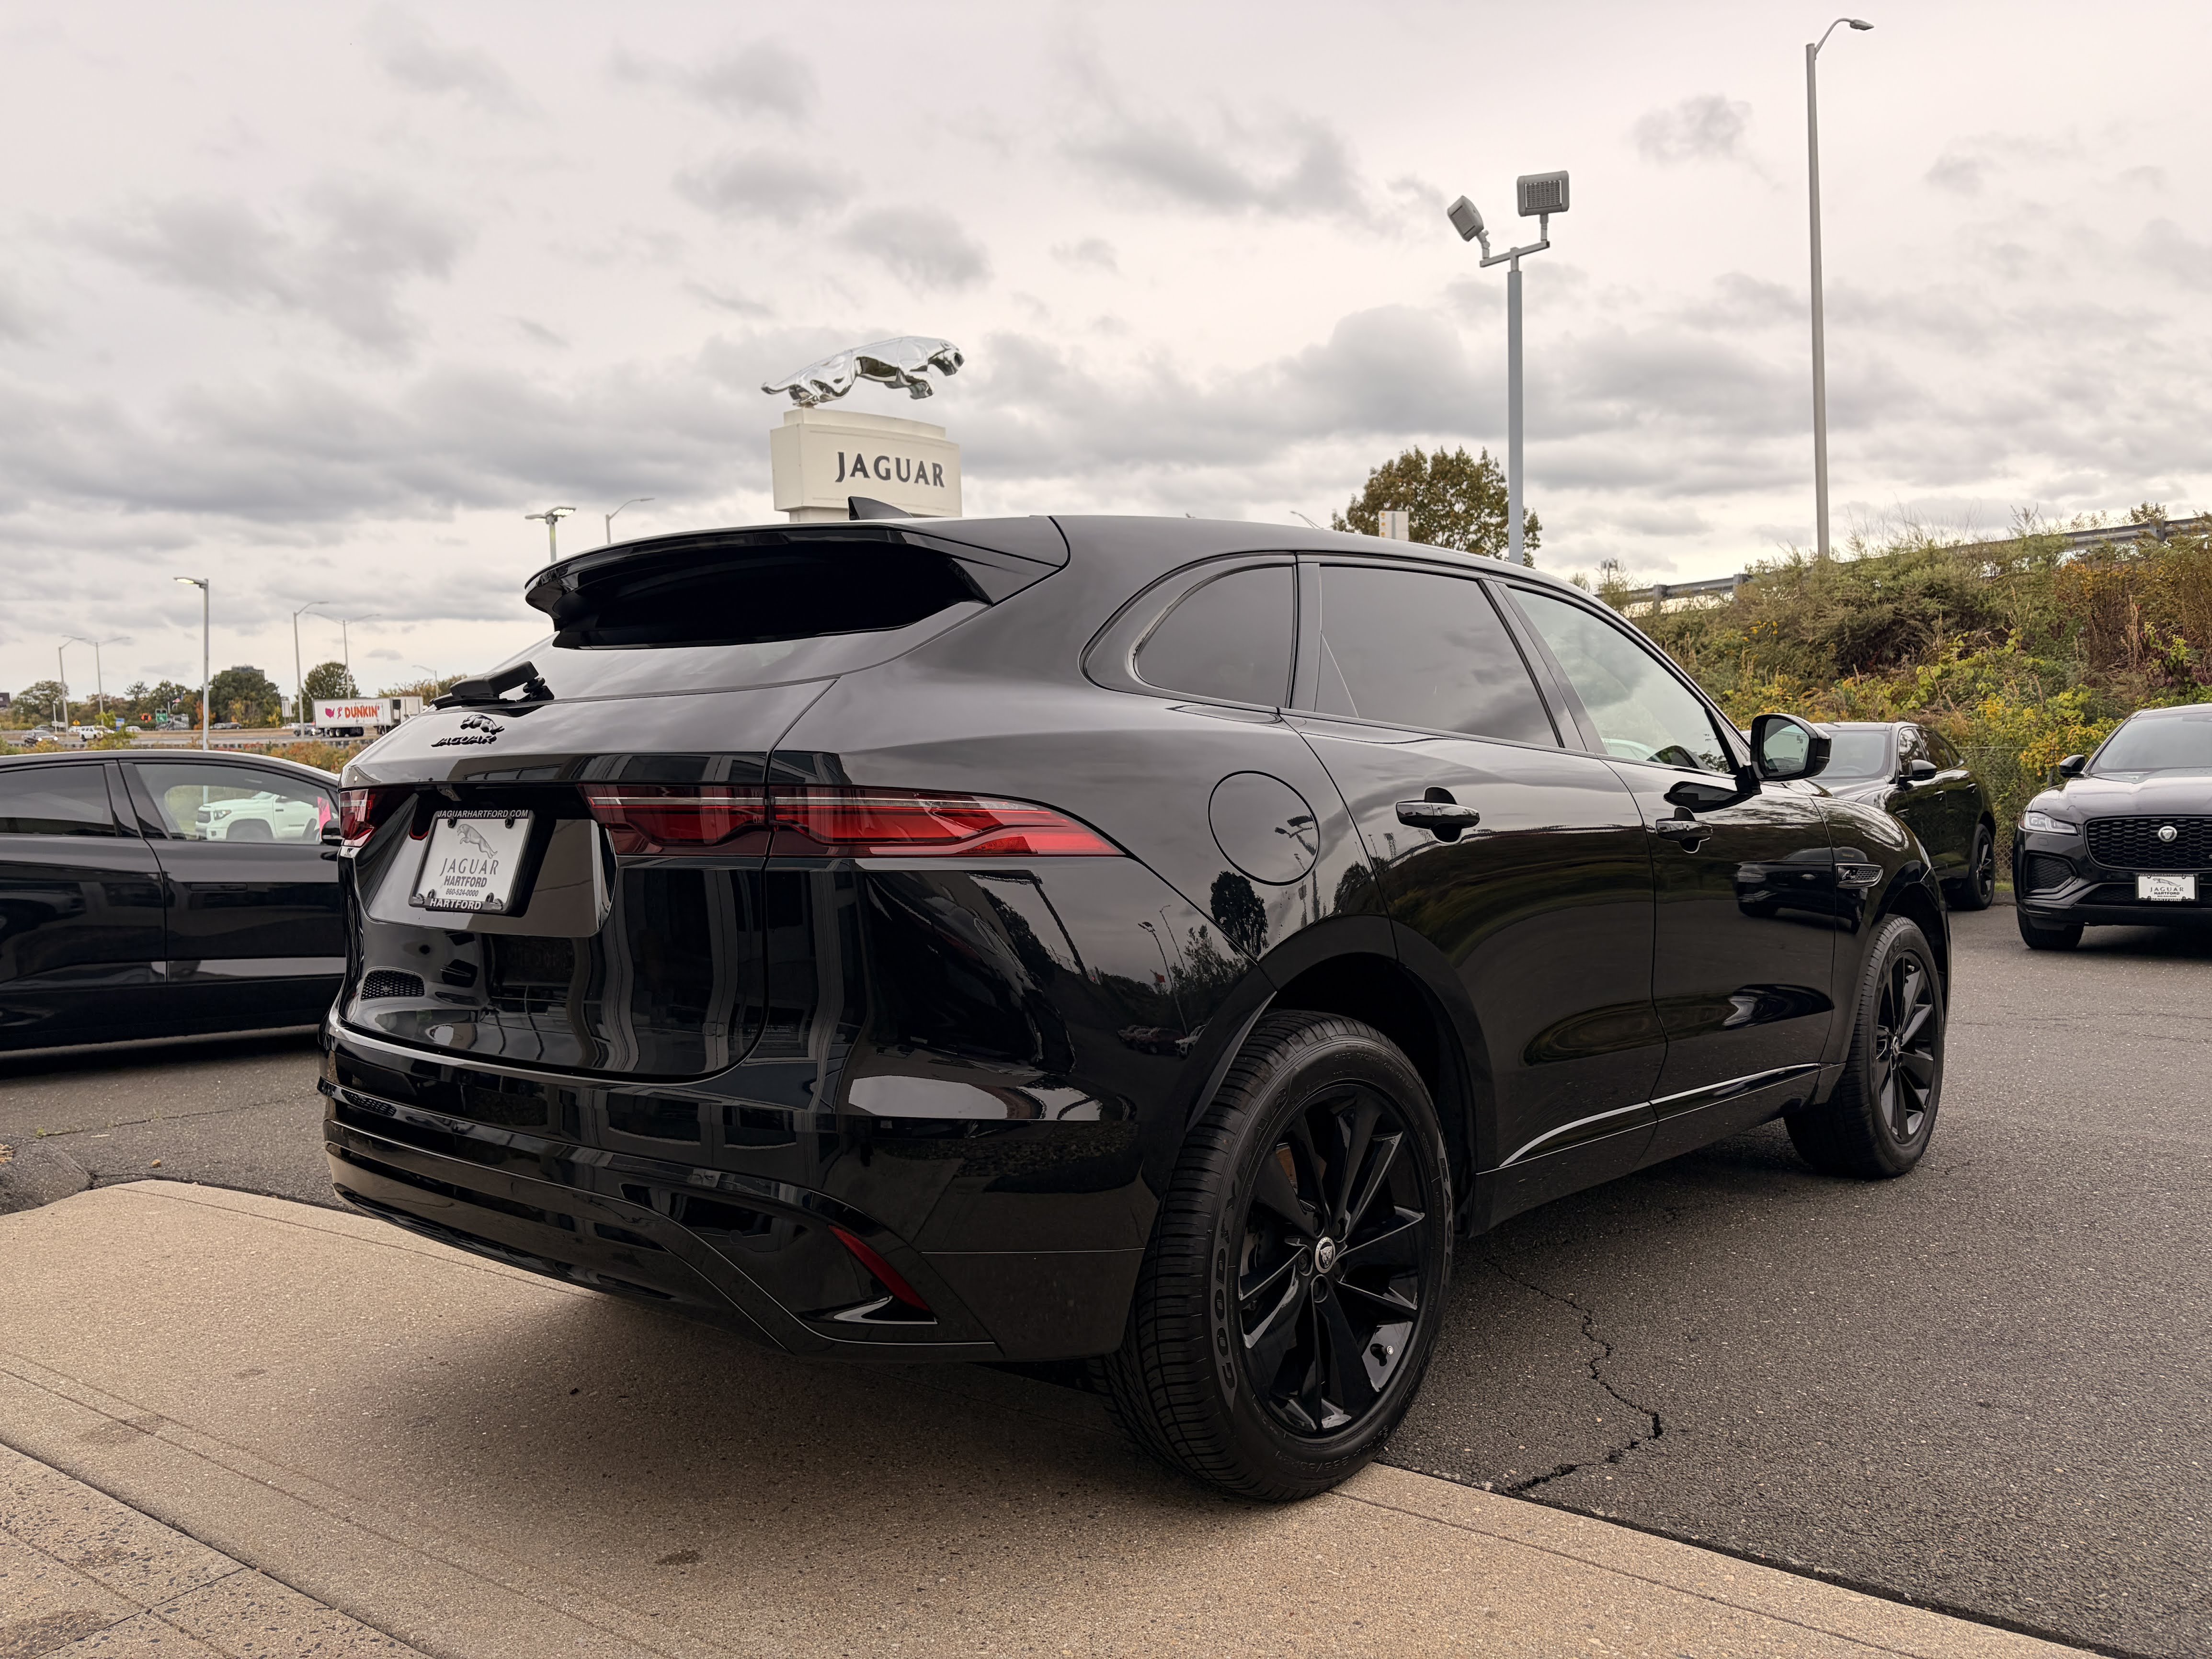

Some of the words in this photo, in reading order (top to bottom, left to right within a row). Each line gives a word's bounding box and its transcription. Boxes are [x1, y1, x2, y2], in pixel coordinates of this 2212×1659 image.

[835, 451, 945, 488] JAGUAR
[344, 705, 379, 719] DUNKIN'
[431, 735, 497, 747] JAGUAR
[437, 809, 528, 818] JAGUARHARTFORDCOM
[439, 858, 499, 876] JAGUAR
[444, 875, 487, 887] HARTFORD
[445, 888, 479, 897] 860-524-0000
[430, 898, 482, 910] HARTFORD
